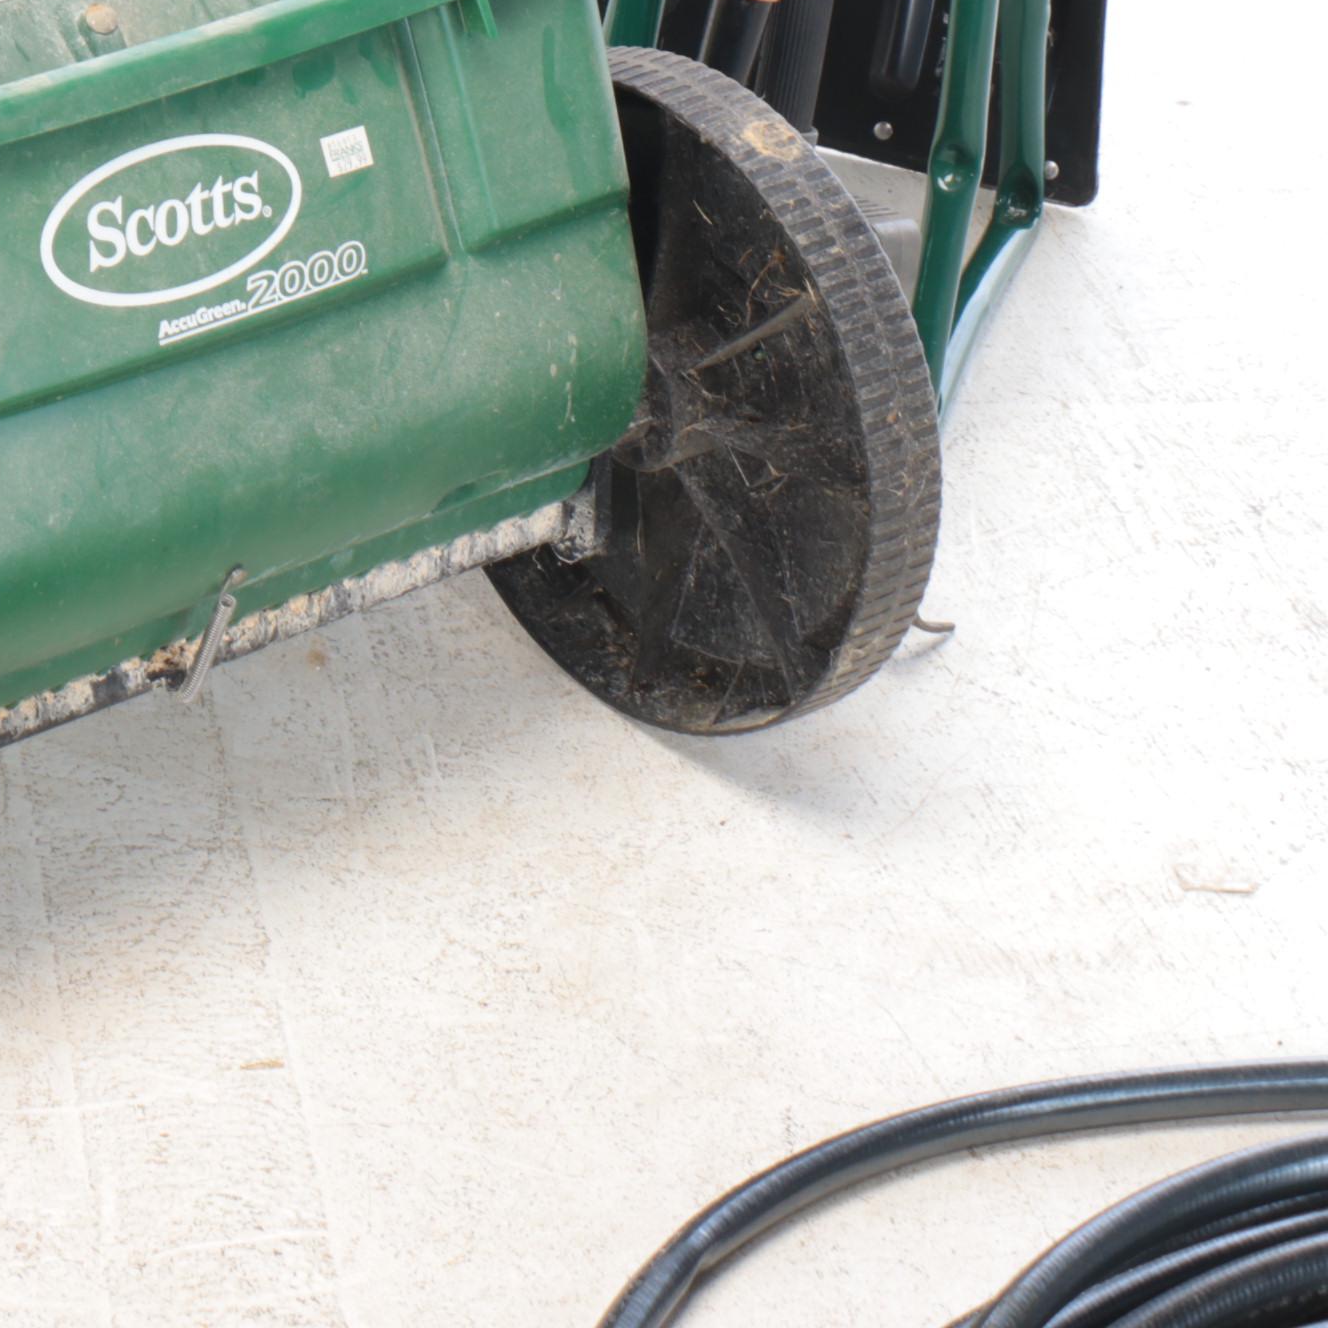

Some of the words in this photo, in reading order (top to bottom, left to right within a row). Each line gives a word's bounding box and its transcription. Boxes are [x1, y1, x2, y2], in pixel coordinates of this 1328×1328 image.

[86, 170, 264, 273] Scotts
[158, 299, 246, 339] AccuGreen
[246, 240, 366, 312] 2000
